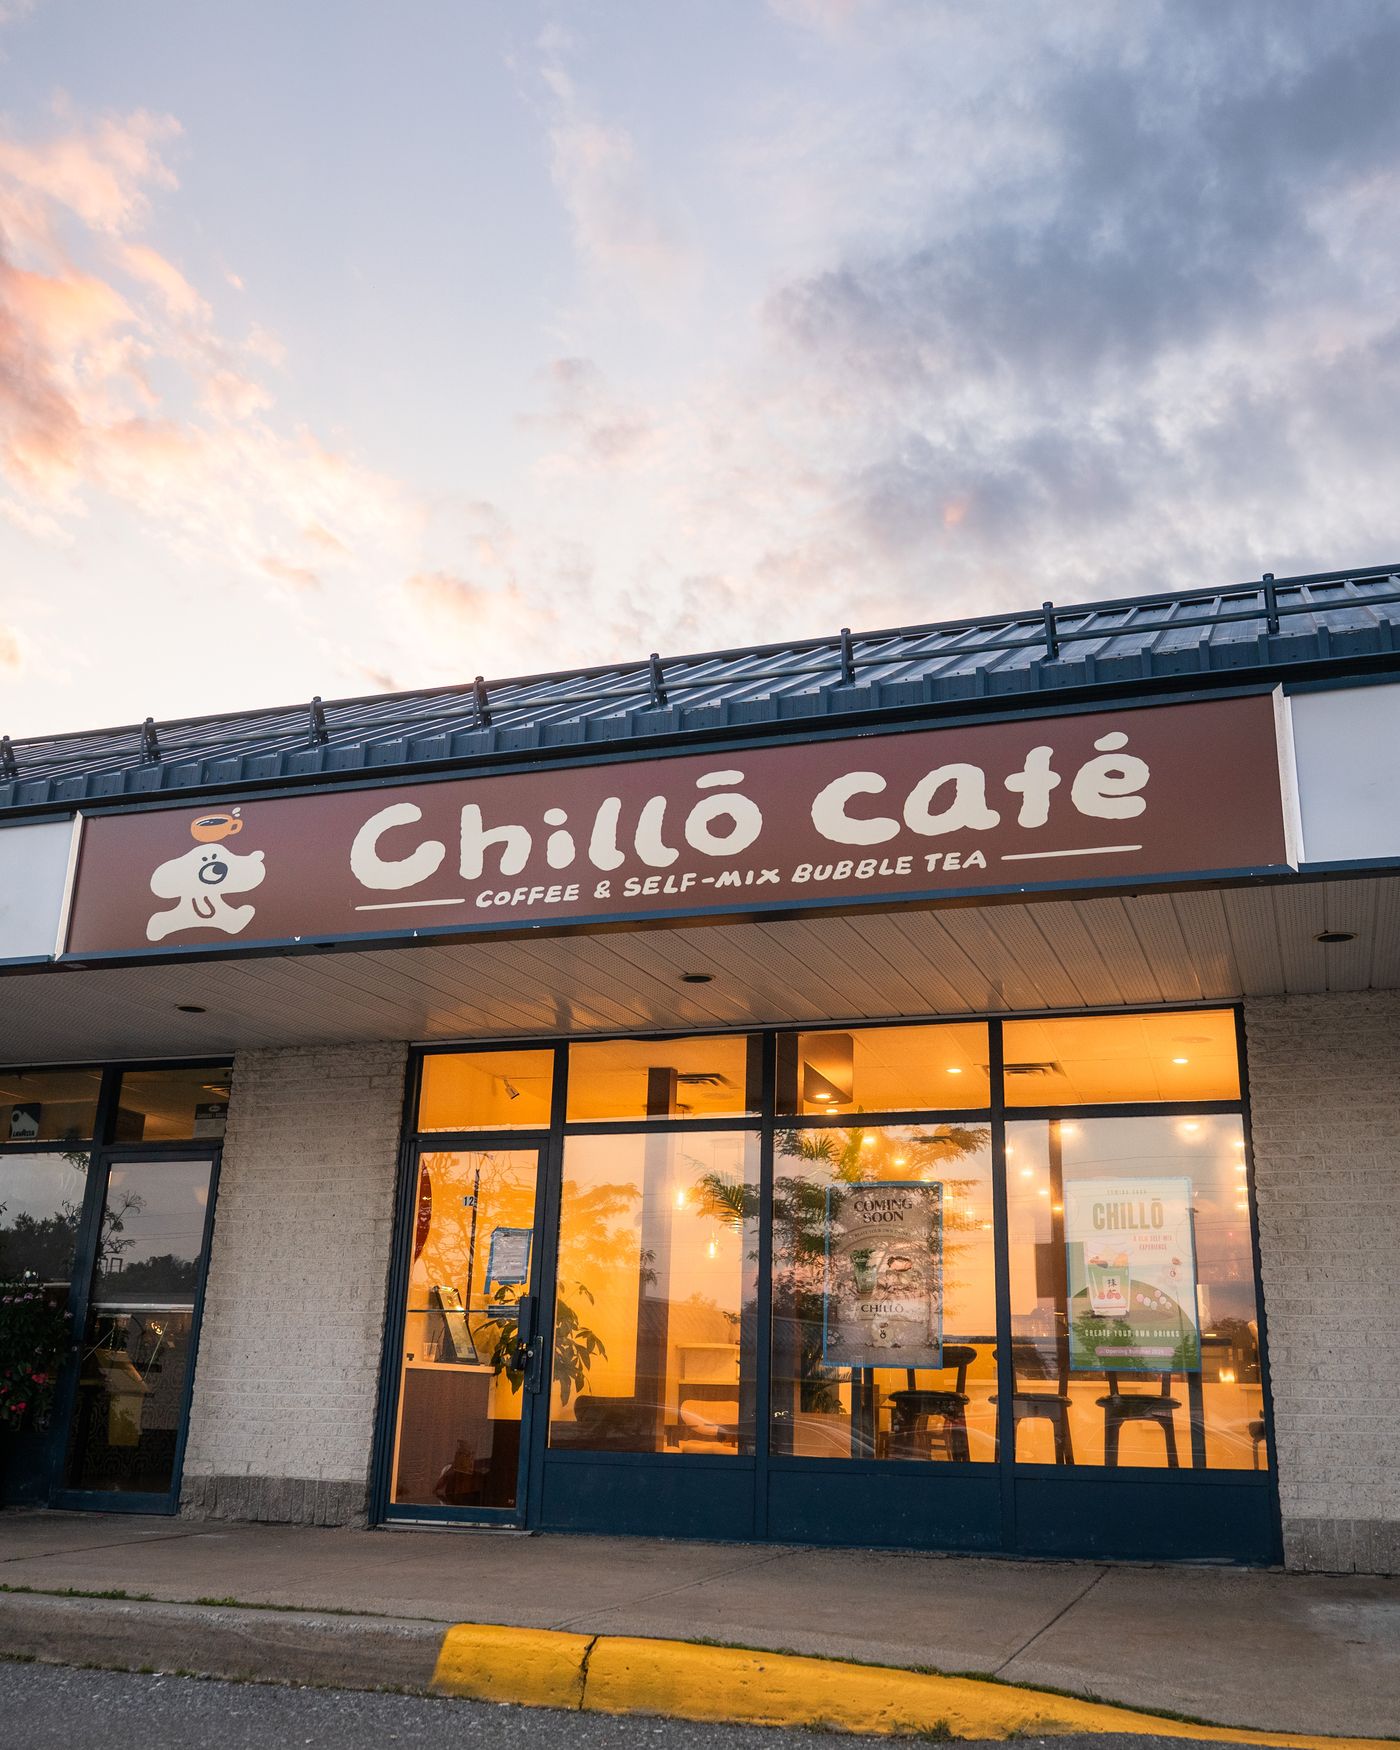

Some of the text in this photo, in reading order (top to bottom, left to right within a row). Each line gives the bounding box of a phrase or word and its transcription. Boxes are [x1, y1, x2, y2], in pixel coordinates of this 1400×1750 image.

[810, 731, 1150, 846] café
[475, 849, 987, 908] COFFEE & SELF-MIX BUBBLE TEA
[854, 1198, 912, 1212] COMING
[863, 1211, 904, 1224] SOON
[1092, 1198, 1164, 1230] CHILLŌ
